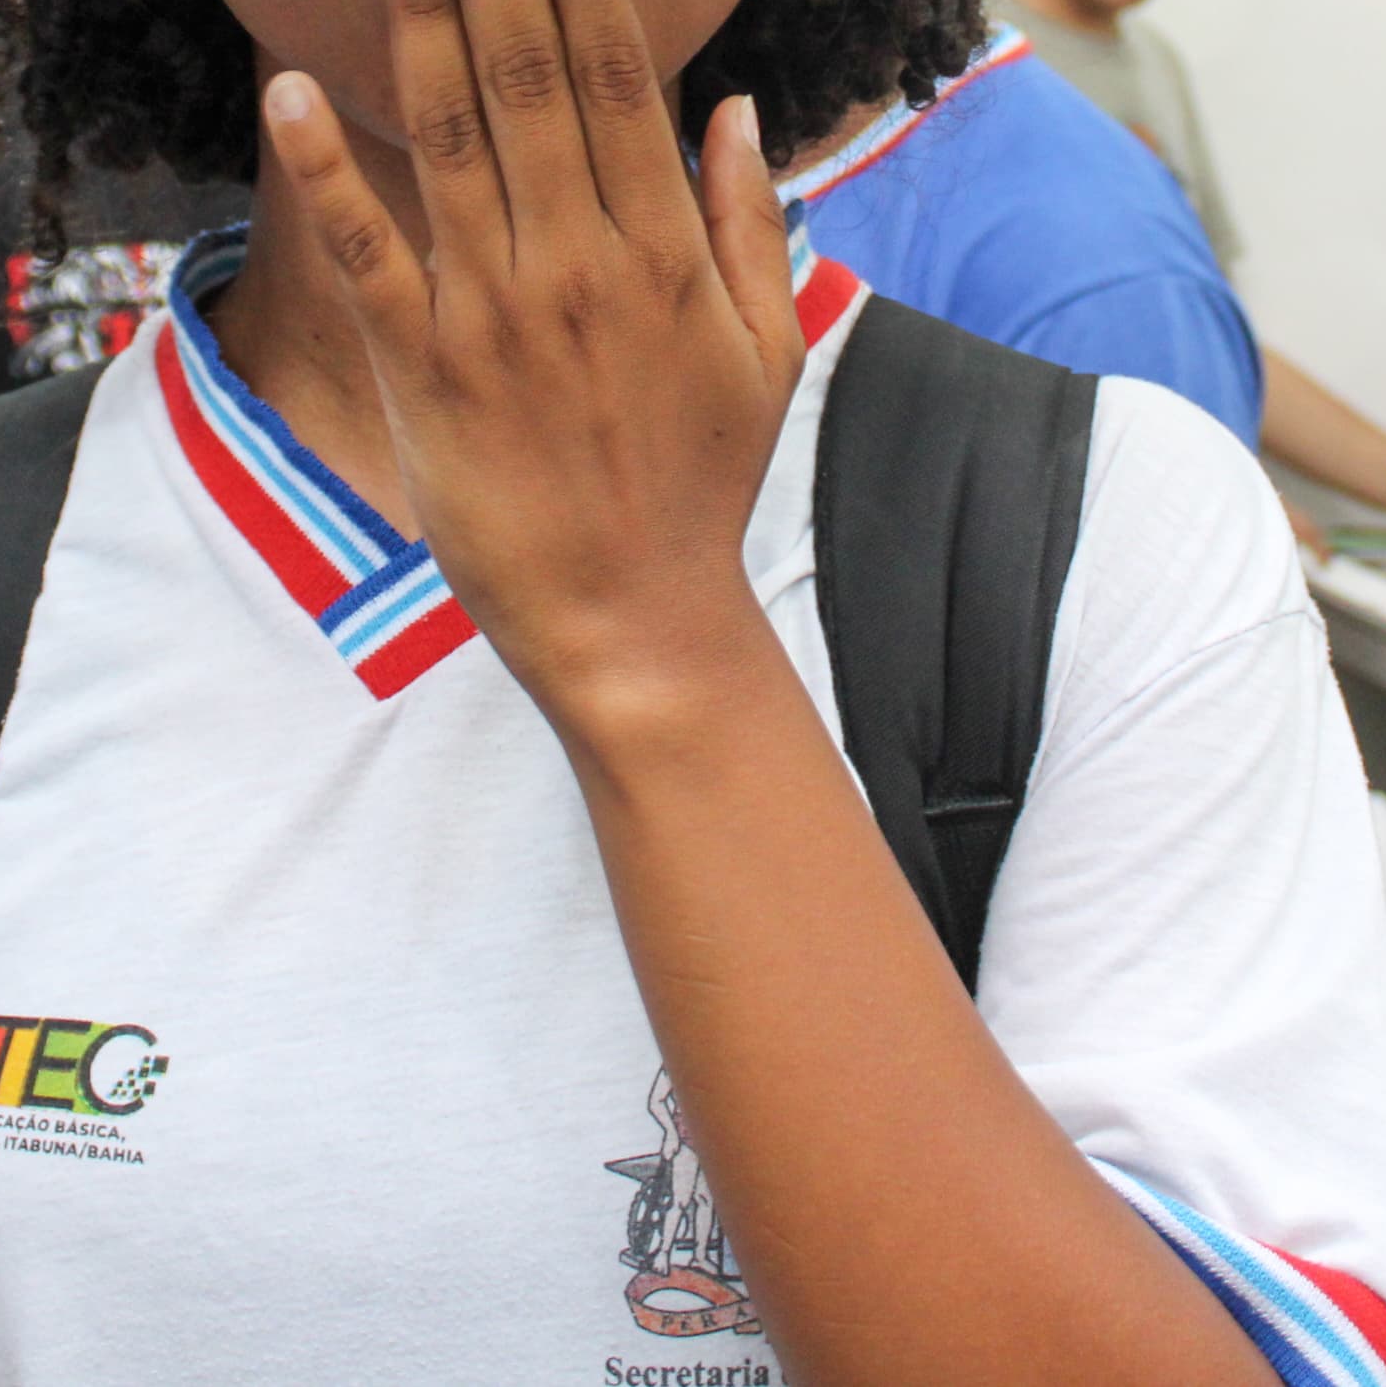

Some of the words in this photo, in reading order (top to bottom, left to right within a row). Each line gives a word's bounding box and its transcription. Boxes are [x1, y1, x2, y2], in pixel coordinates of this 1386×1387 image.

[54, 1117, 125, 1143] BÁSICA,
[4, 1135, 144, 1165] ITABUNA/BAHIA
[604, 1356, 770, 1387] Secretaria
